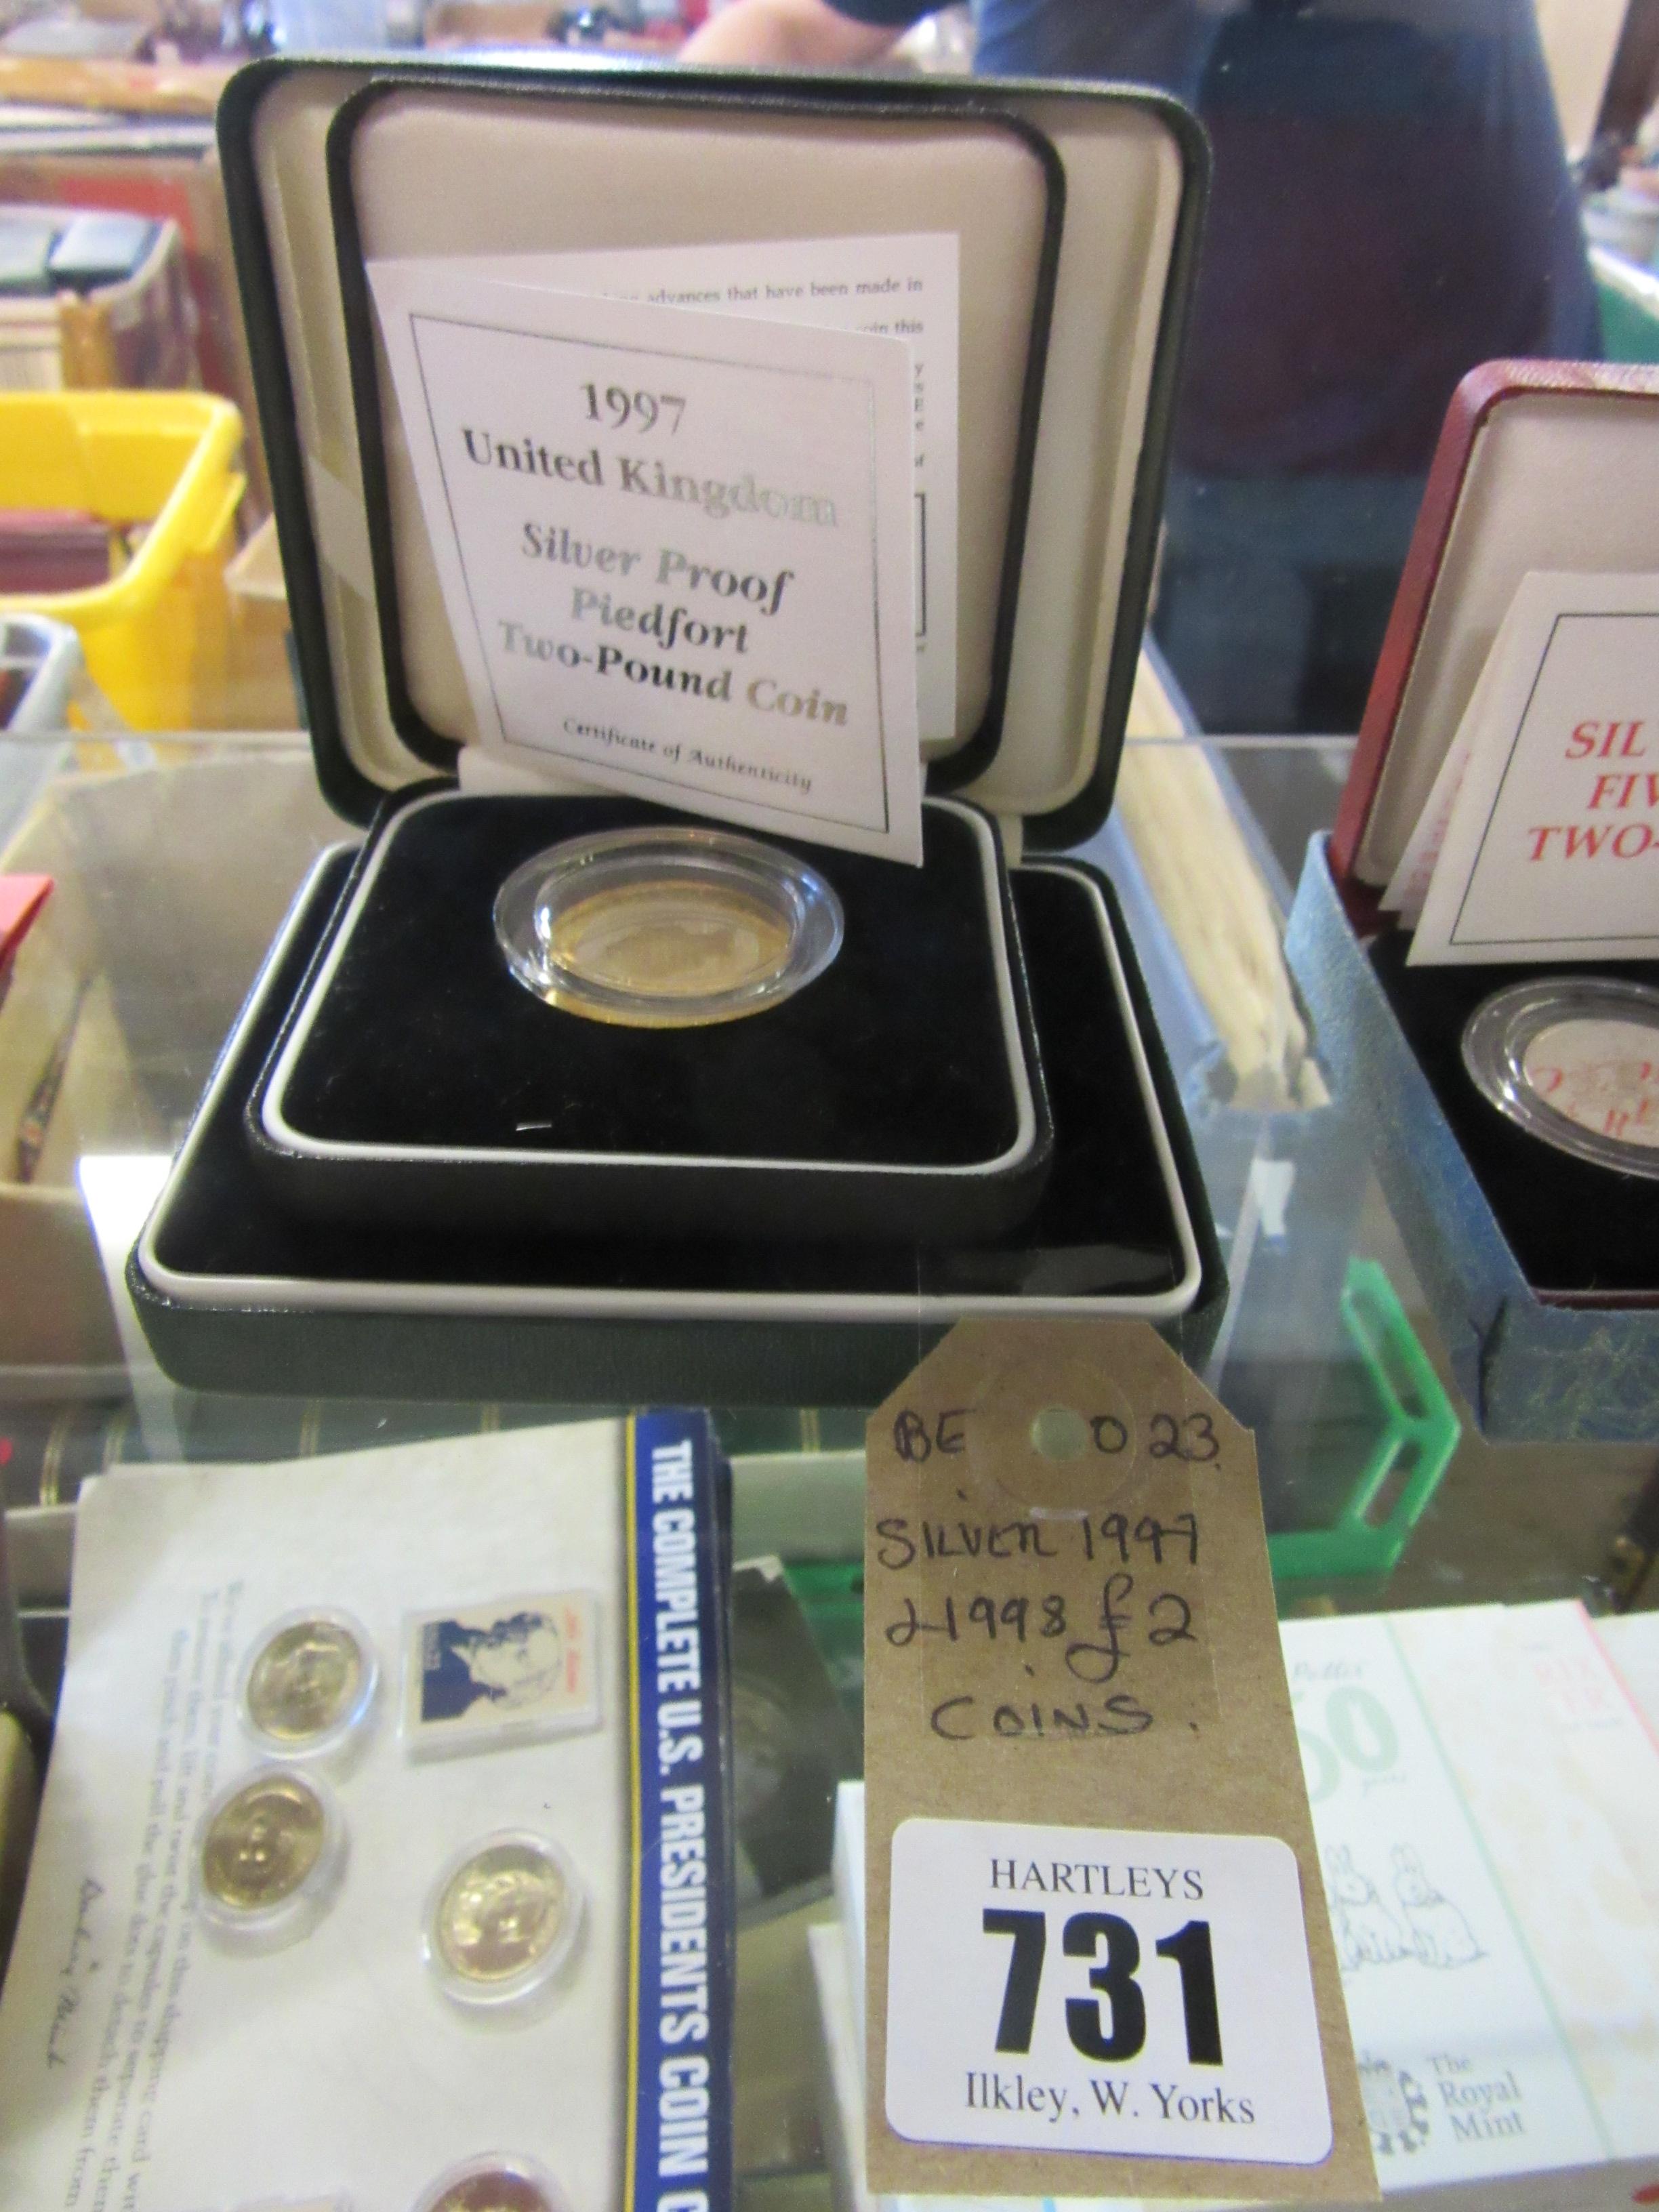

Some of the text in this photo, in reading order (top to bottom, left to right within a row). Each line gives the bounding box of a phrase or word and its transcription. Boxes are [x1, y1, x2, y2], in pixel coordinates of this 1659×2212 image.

[647, 286, 720, 303] advances
[727, 284, 758, 301] that
[766, 282, 804, 299] have
[811, 281, 848, 296] been
[856, 278, 901, 294] made
[907, 279, 923, 291] in
[895, 319, 924, 333] this
[579, 381, 687, 436] 1997
[462, 427, 839, 528] United Kingdom
[521, 520, 795, 615] Silver Proof
[571, 587, 750, 655] Piedfort
[497, 619, 849, 727] Two-Pound Coin
[562, 716, 813, 794] Certificate of Authenticity
[893, 1407, 976, 1463] BE
[651, 1439, 694, 1504] THE
[1080, 1512, 1199, 1564] 1997
[653, 1507, 702, 1694] COMPLETE
[657, 1699, 705, 1776] U.S.
[930, 1694, 1153, 1741] COINS
[989, 1858, 1205, 1900] HARTLEYS
[659, 1783, 710, 2045] PRESIDENTS
[982, 1908, 1224, 2068] 731
[1427, 2052, 1472, 2074] The
[1437, 2070, 1523, 2111] Royal
[85, 2074, 110, 2139] them
[658, 2054, 711, 2177] COIN
[966, 2071, 1256, 2125] Ilkley, W. Yorks
[1448, 2108, 1526, 2142] Mint
[131, 2110, 151, 2163] card
[65, 2147, 97, 2207] from
